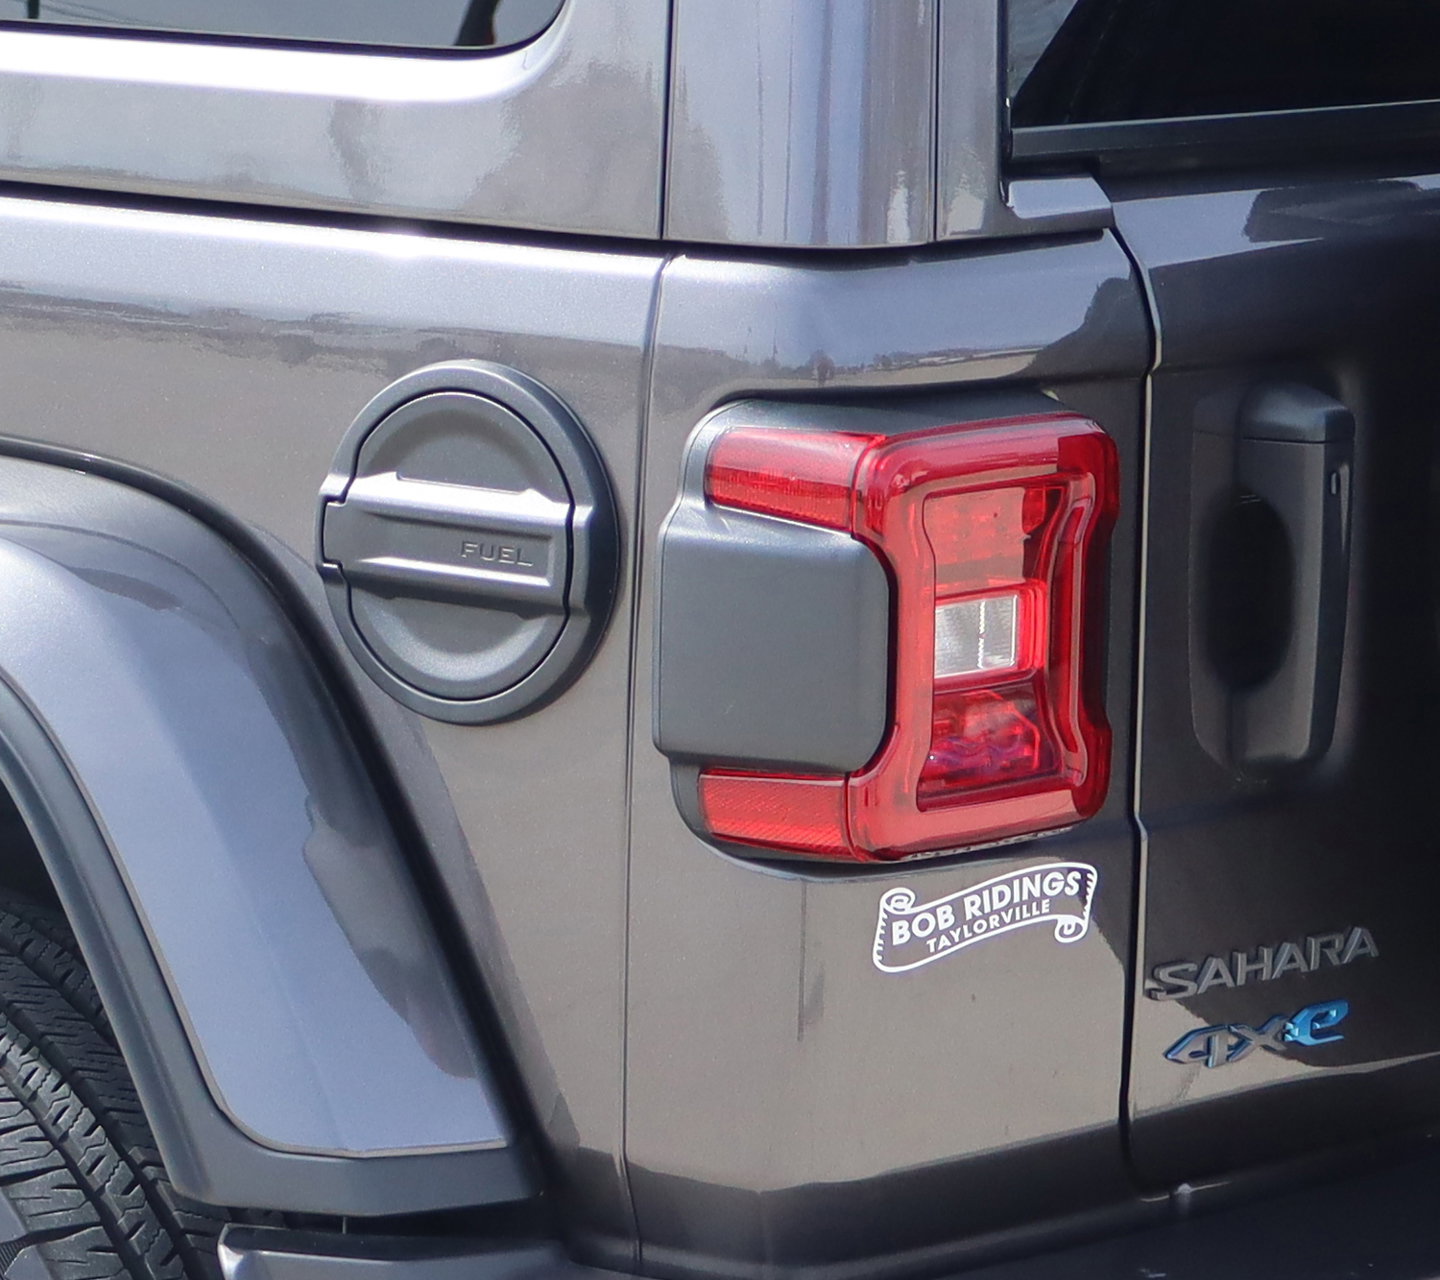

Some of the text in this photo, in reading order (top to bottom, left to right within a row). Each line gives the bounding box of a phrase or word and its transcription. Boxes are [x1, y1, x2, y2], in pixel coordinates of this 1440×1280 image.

[461, 540, 533, 567] FUEL
[892, 871, 1081, 946] BOB RIDINGS
[926, 898, 1051, 953] TAYLORVILLE
[1144, 925, 1380, 1002] SAHARA
